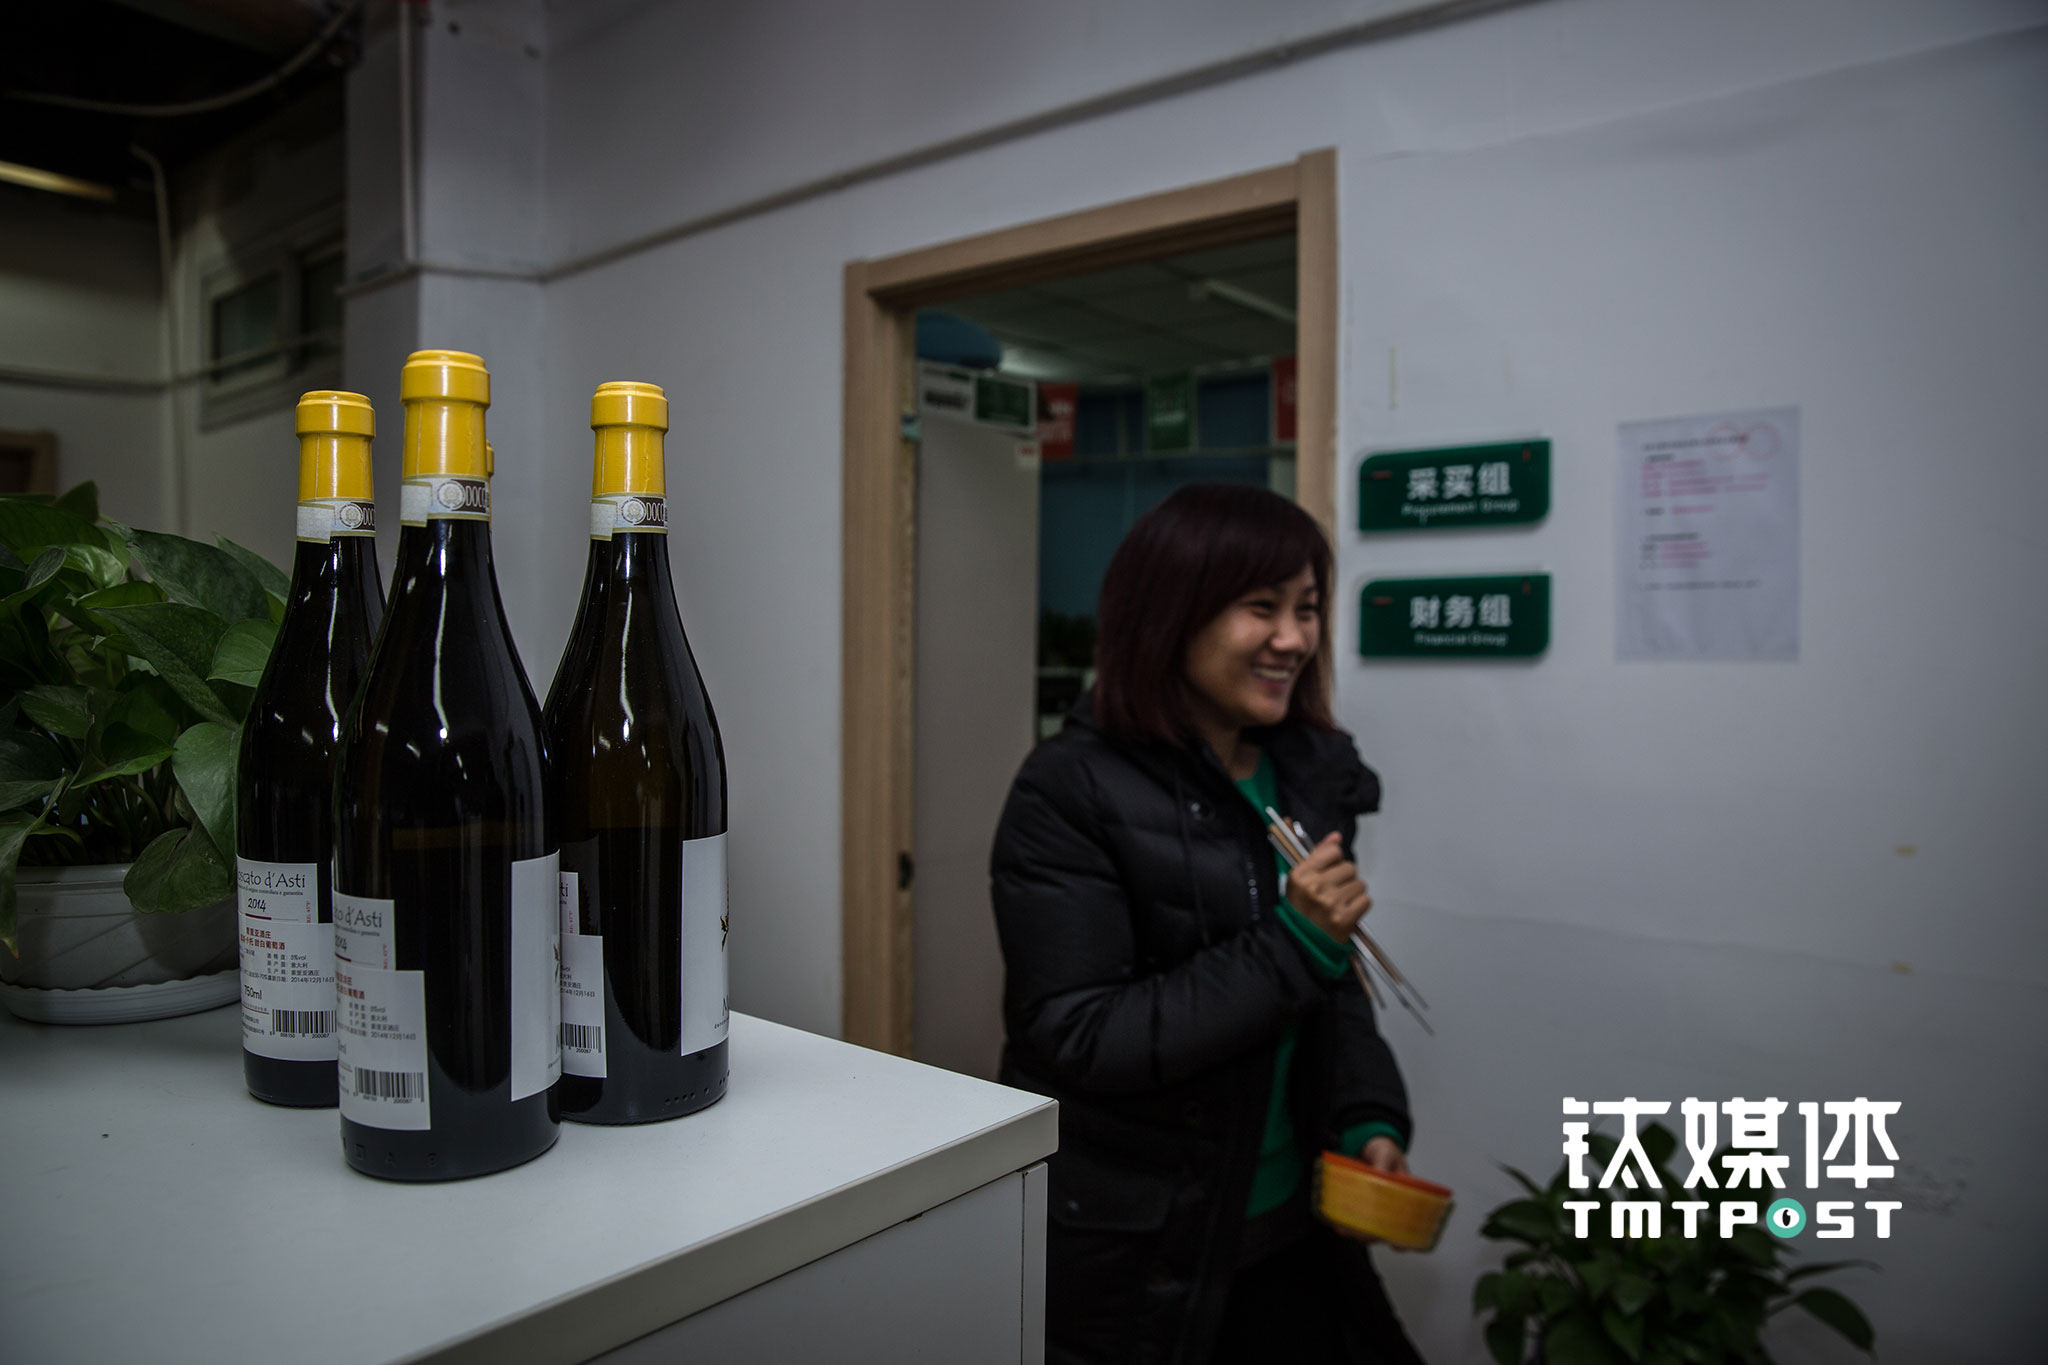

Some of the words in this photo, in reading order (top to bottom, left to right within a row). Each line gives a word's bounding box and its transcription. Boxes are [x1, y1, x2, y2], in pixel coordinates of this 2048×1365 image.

[1407, 462, 1511, 500] 采买组
[1410, 594, 1511, 628] 财务组
[265, 871, 305, 889] d'Asti
[248, 897, 267, 912] 2014
[344, 905, 383, 928] d'Asti
[291, 976, 335, 984] 2014年12月16日
[244, 985, 263, 1000] 750ml
